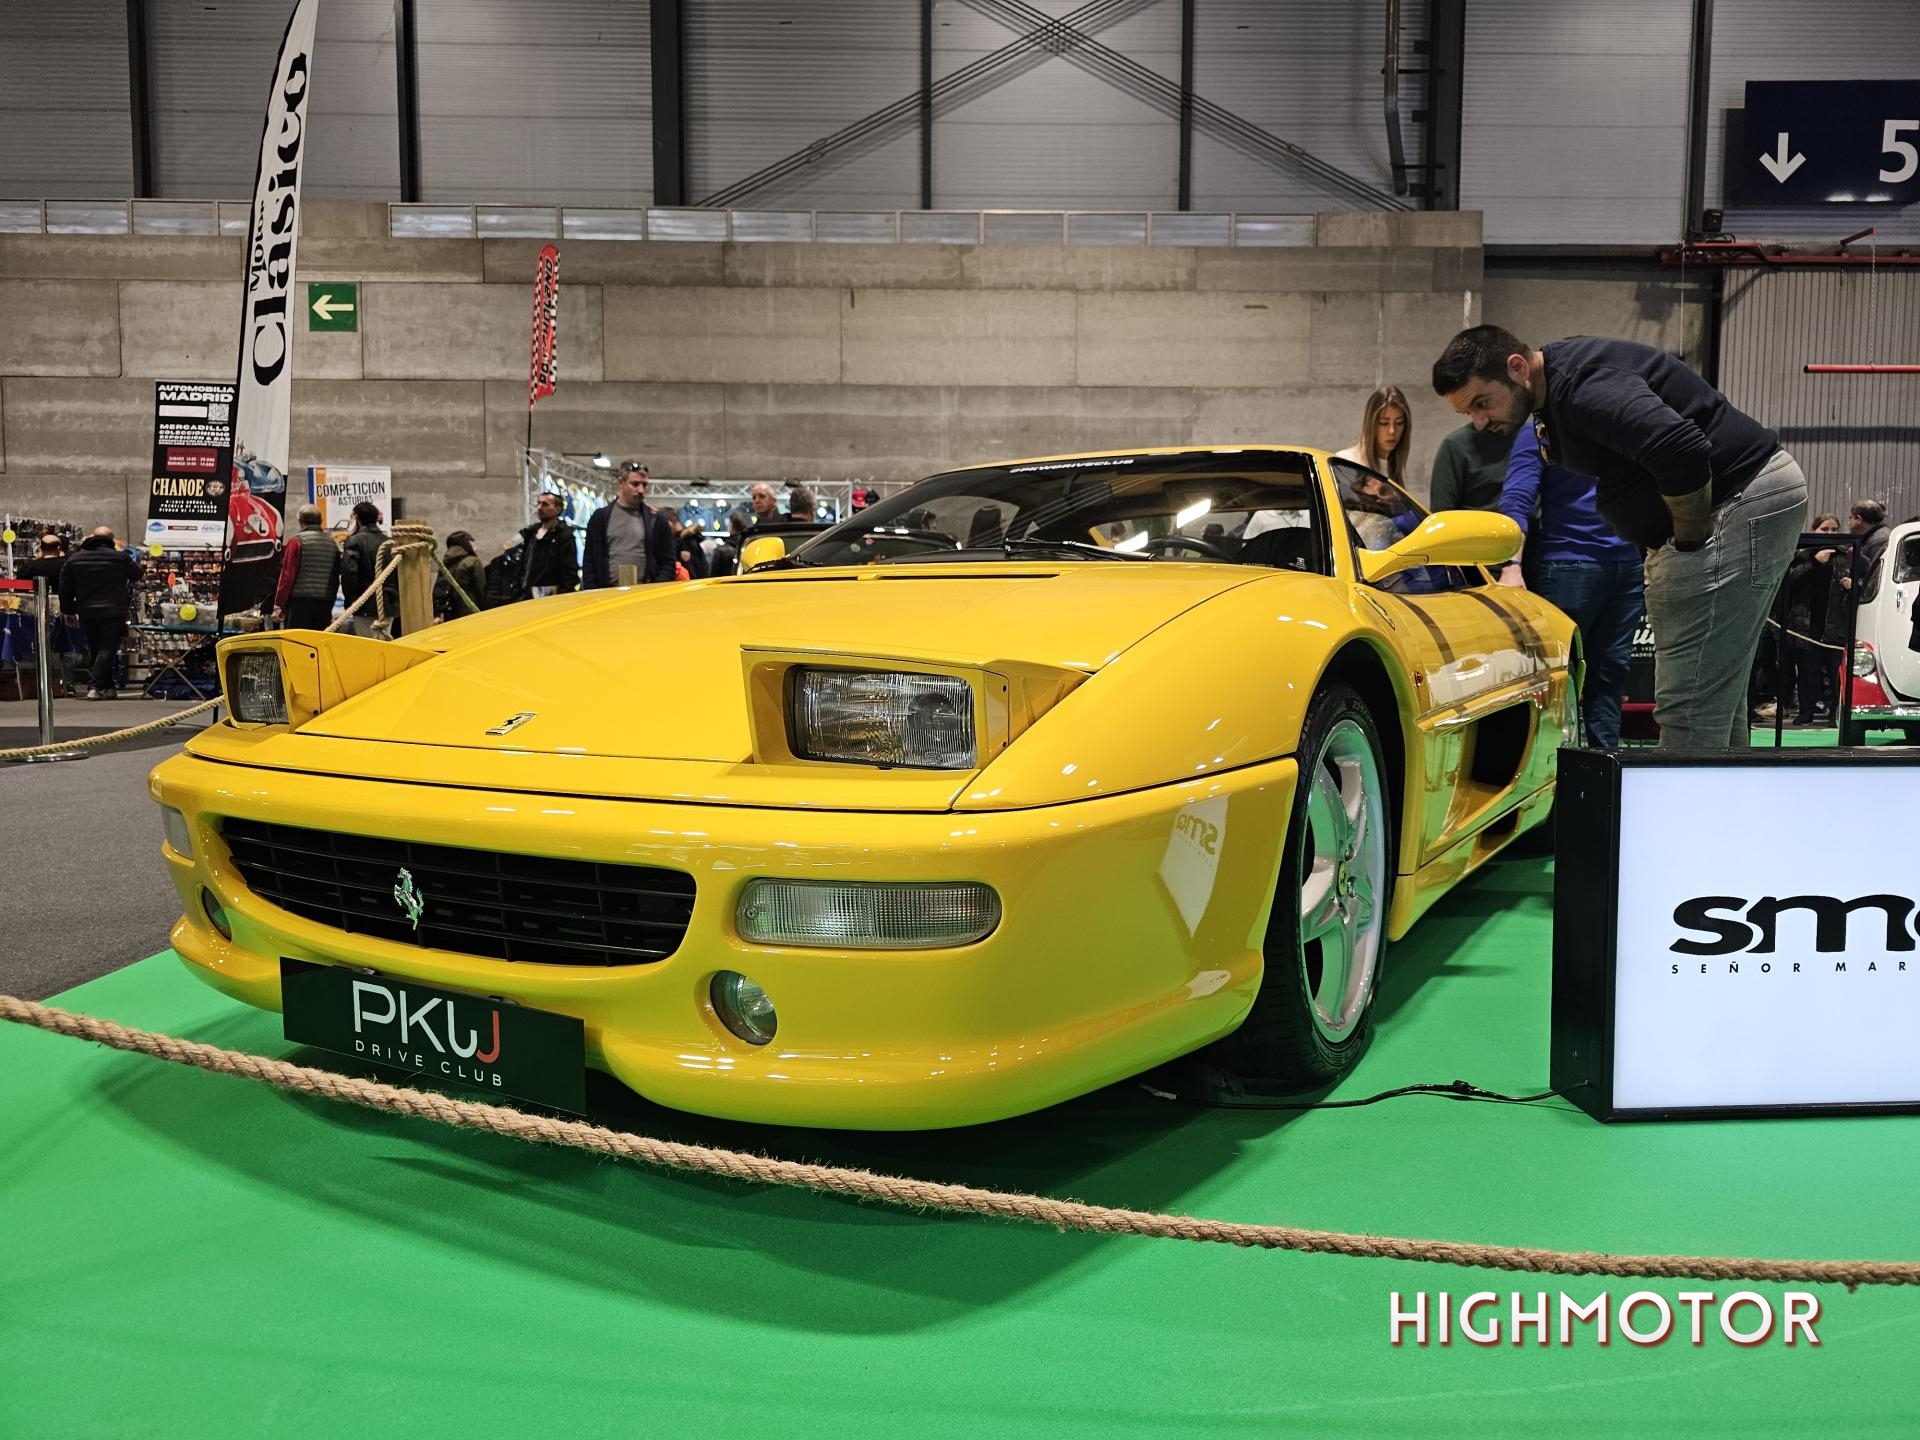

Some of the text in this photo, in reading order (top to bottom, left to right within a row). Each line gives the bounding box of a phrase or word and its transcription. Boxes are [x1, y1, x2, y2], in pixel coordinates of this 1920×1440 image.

[1879, 119, 1920, 183] 5
[250, 200, 265, 292] Motor
[158, 385, 235, 393] AUTOMOBILIA
[160, 391, 233, 402] MADRID
[159, 424, 230, 432] MERCADILLO
[152, 478, 205, 497] CHANOE
[317, 480, 385, 497] COMPETICIÓN
[1669, 894, 1920, 956] sm
[1672, 961, 1906, 974] SEÑOR MAR
[355, 1039, 502, 1087] DRIVE CLUB
